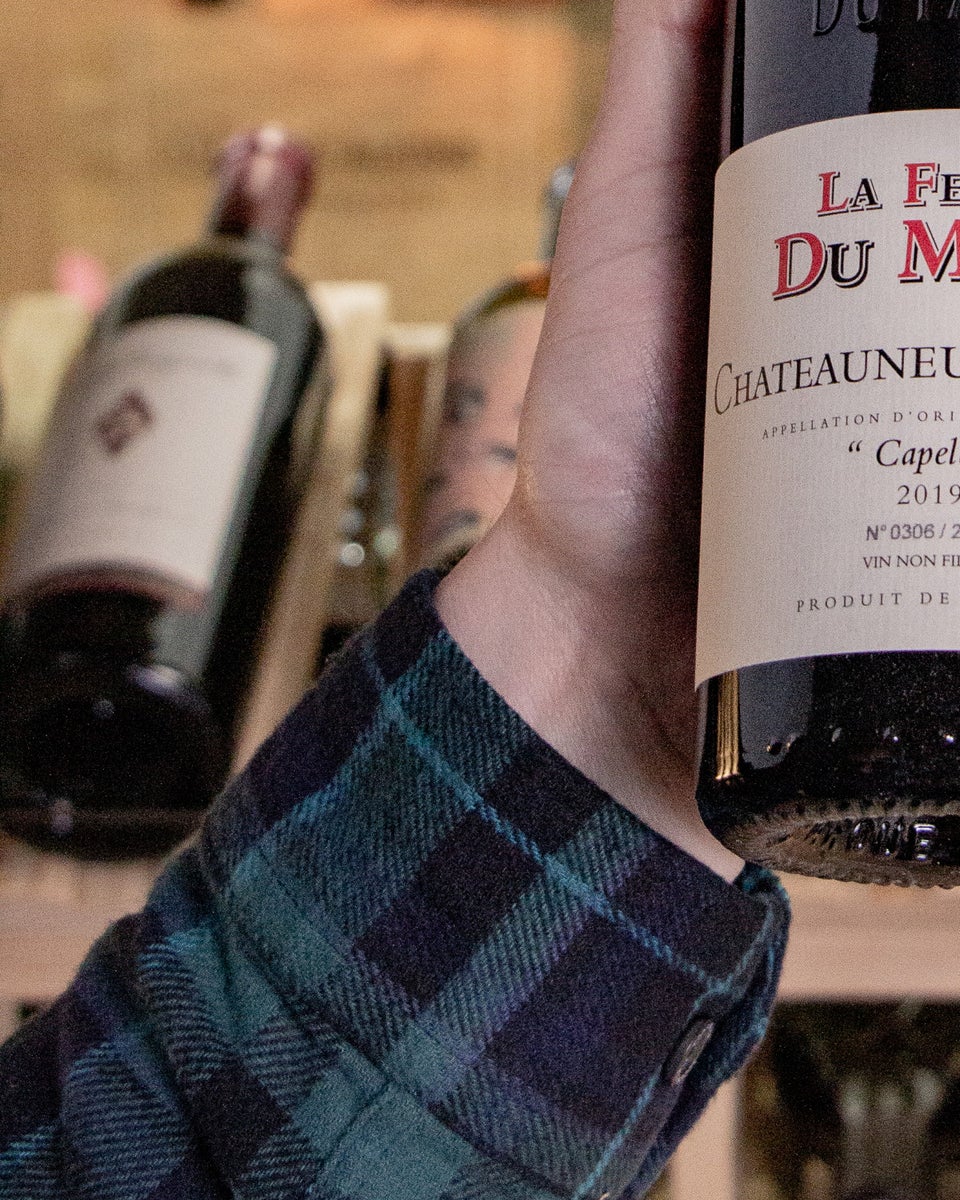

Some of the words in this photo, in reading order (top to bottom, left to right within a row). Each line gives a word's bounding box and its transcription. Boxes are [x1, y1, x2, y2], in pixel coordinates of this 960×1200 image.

[816, 171, 883, 218] LA
[771, 231, 875, 302] DU
[762, 411, 882, 440] APPELLATION
[862, 555, 892, 569] VIN
[896, 554, 936, 568] NON
[796, 592, 903, 613] PRODUIT
[919, 592, 951, 606] DE
